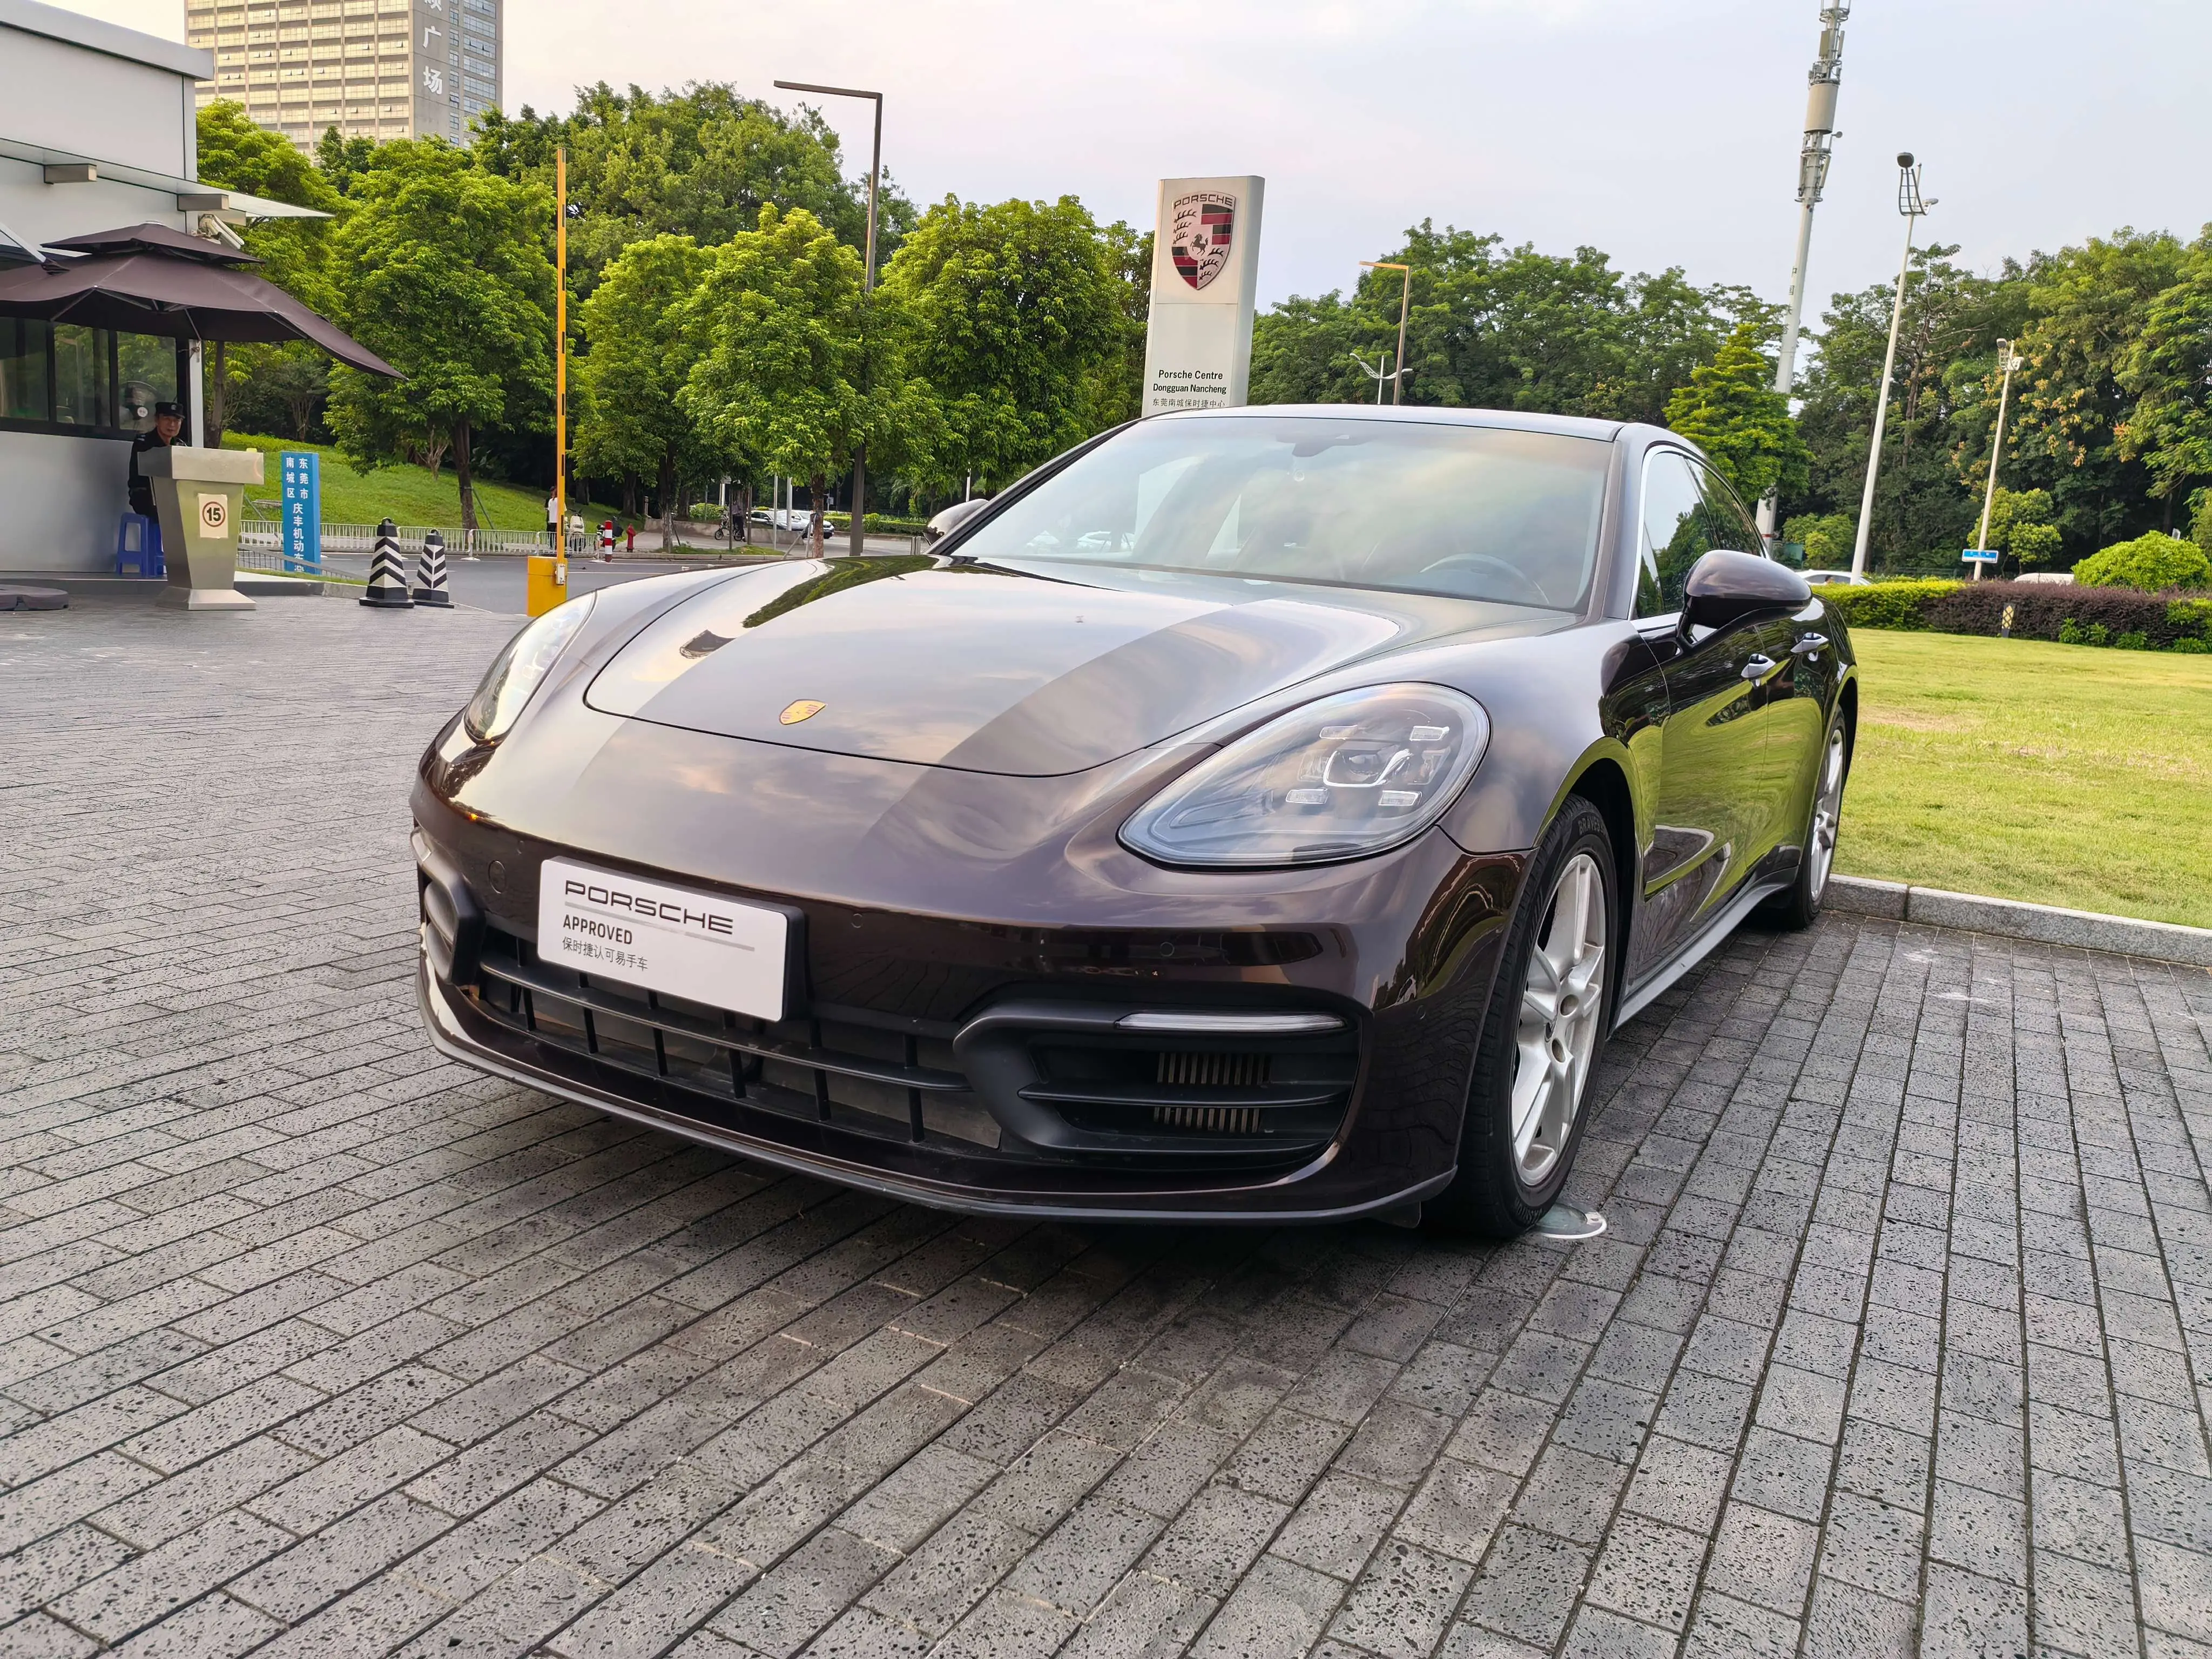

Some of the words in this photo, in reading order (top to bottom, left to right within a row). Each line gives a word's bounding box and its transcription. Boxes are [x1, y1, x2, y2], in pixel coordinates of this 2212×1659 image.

[1174, 194, 1233, 209] PORSCHE
[1158, 369, 1192, 379] Porsche
[1195, 370, 1223, 380] Centre
[1153, 383, 1189, 393] Dongguan
[1190, 385, 1227, 395] Nancheng
[1153, 398, 1225, 408] 东莞南城保时捷中心
[286, 457, 295, 498] 南城区
[299, 458, 309, 500] 东莞市
[207, 507, 221, 522] 15
[565, 880, 733, 935] PORSCHE
[563, 914, 632, 945] APPROVED
[562, 936, 648, 972] 保时捷认可易手车
